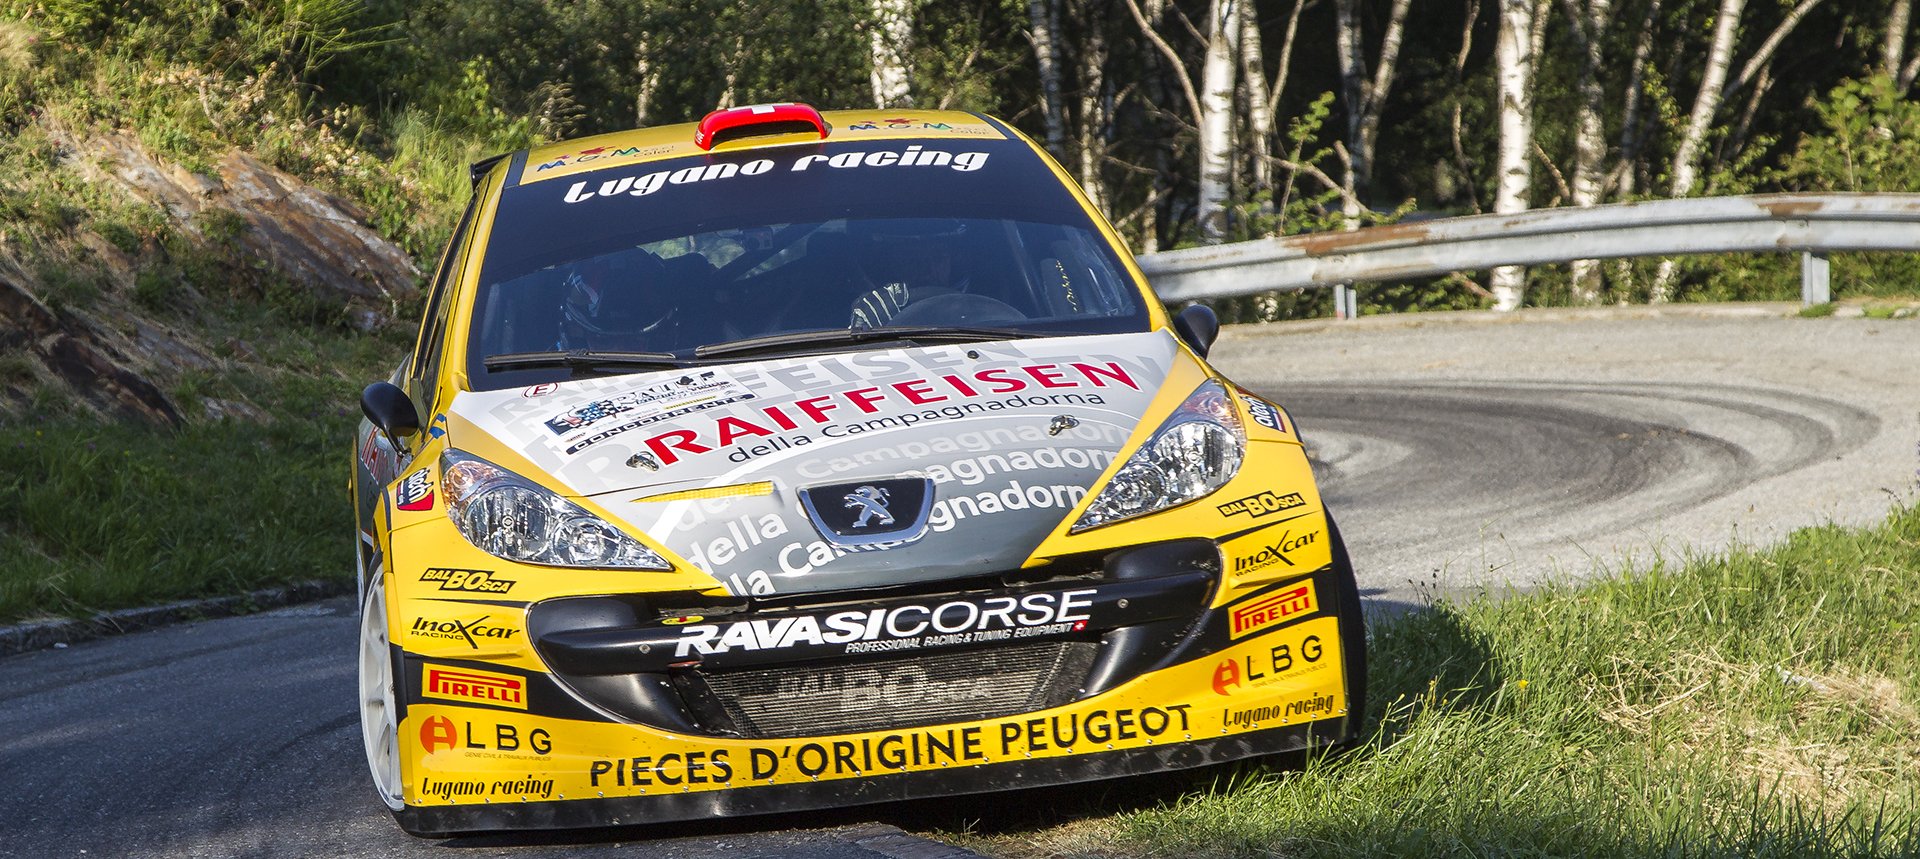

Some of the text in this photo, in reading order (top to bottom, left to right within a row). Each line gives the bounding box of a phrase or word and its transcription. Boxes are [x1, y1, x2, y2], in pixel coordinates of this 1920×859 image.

[791, 145, 990, 172] racing
[574, 395, 746, 451] CONCORRENTE
[644, 362, 1140, 465] RAIFFEISEN
[728, 392, 1106, 463] della Campagnadorna
[1220, 493, 1304, 516] BALBOSCA
[423, 569, 511, 592] BALBOSCA
[1235, 559, 1279, 577] RACING
[1233, 586, 1310, 634] PIRELLI
[411, 631, 464, 640] RACING
[844, 637, 921, 654] PROFESSIONAL
[1013, 622, 1074, 639] EQUIPMENT
[429, 669, 521, 703] PIRELLI
[1285, 692, 1334, 717] racing
[590, 704, 1192, 787] PIECES D'ORIGINE PEUGEOT
[490, 774, 554, 799] racing
